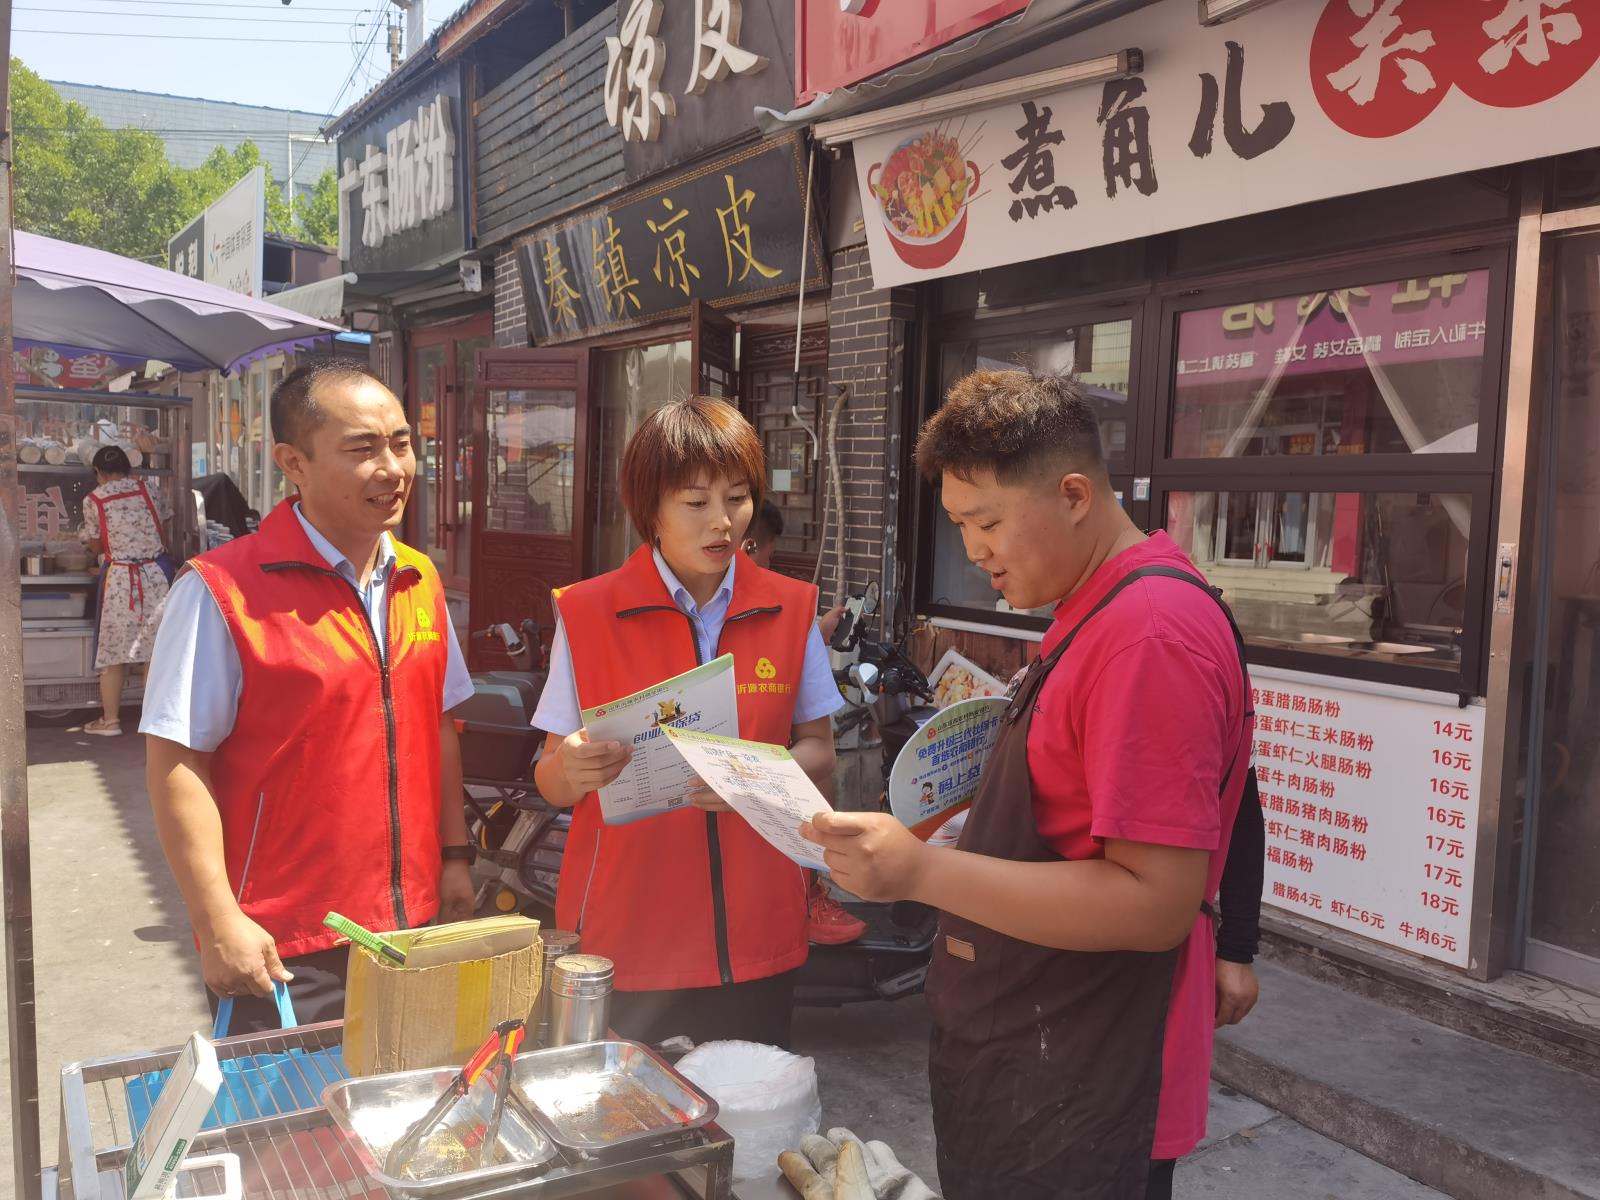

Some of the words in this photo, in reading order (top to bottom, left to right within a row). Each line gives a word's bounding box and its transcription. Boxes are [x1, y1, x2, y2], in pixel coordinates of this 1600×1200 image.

[1001, 40, 1296, 222] 煮角儿
[337, 93, 455, 262] 广东肠粉
[543, 174, 783, 329] 秦镇凉皮
[1433, 720, 1472, 742] 14元
[1432, 749, 1472, 772] 16元
[1430, 778, 1469, 800] 16元
[1427, 806, 1466, 829] 16元
[1264, 818, 1367, 861] 虾仁猪肉肠粉
[1424, 863, 1462, 888] 17元
[1425, 835, 1464, 859] 17元
[1420, 892, 1459, 916] 18元
[1272, 881, 1323, 910] 腊肠4元
[1330, 900, 1385, 930] 虾仁6元
[1398, 921, 1457, 952] 牛肉6元
